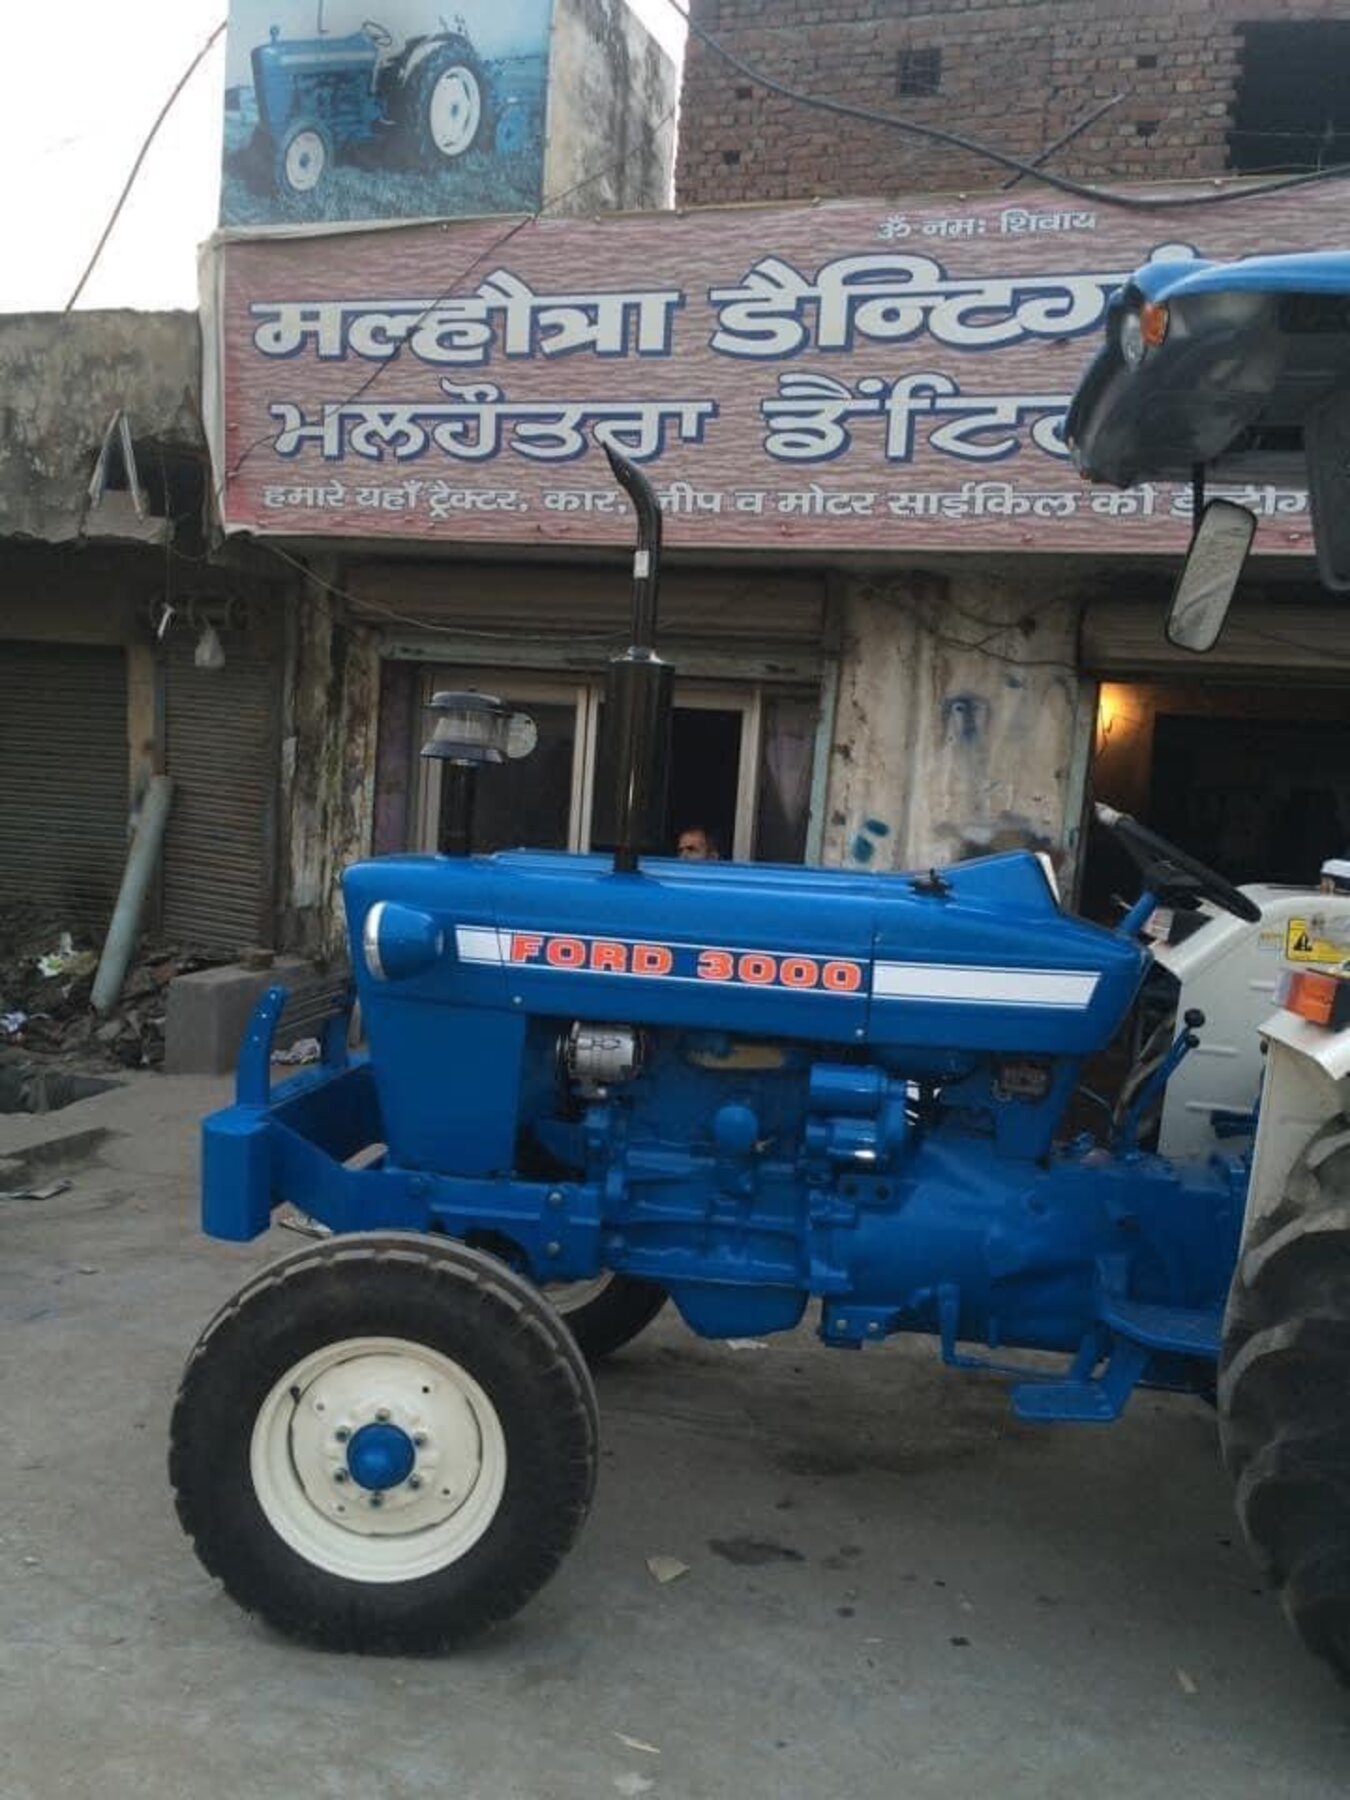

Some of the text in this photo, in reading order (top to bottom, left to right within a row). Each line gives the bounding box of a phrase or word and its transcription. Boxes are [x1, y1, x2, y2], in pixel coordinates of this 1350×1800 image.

[1000, 208, 1096, 233] शिवाय
[263, 480, 346, 509] हमारे
[735, 489, 767, 513] व
[777, 483, 880, 515] मोटर
[510, 934, 863, 992] FORD 3000
